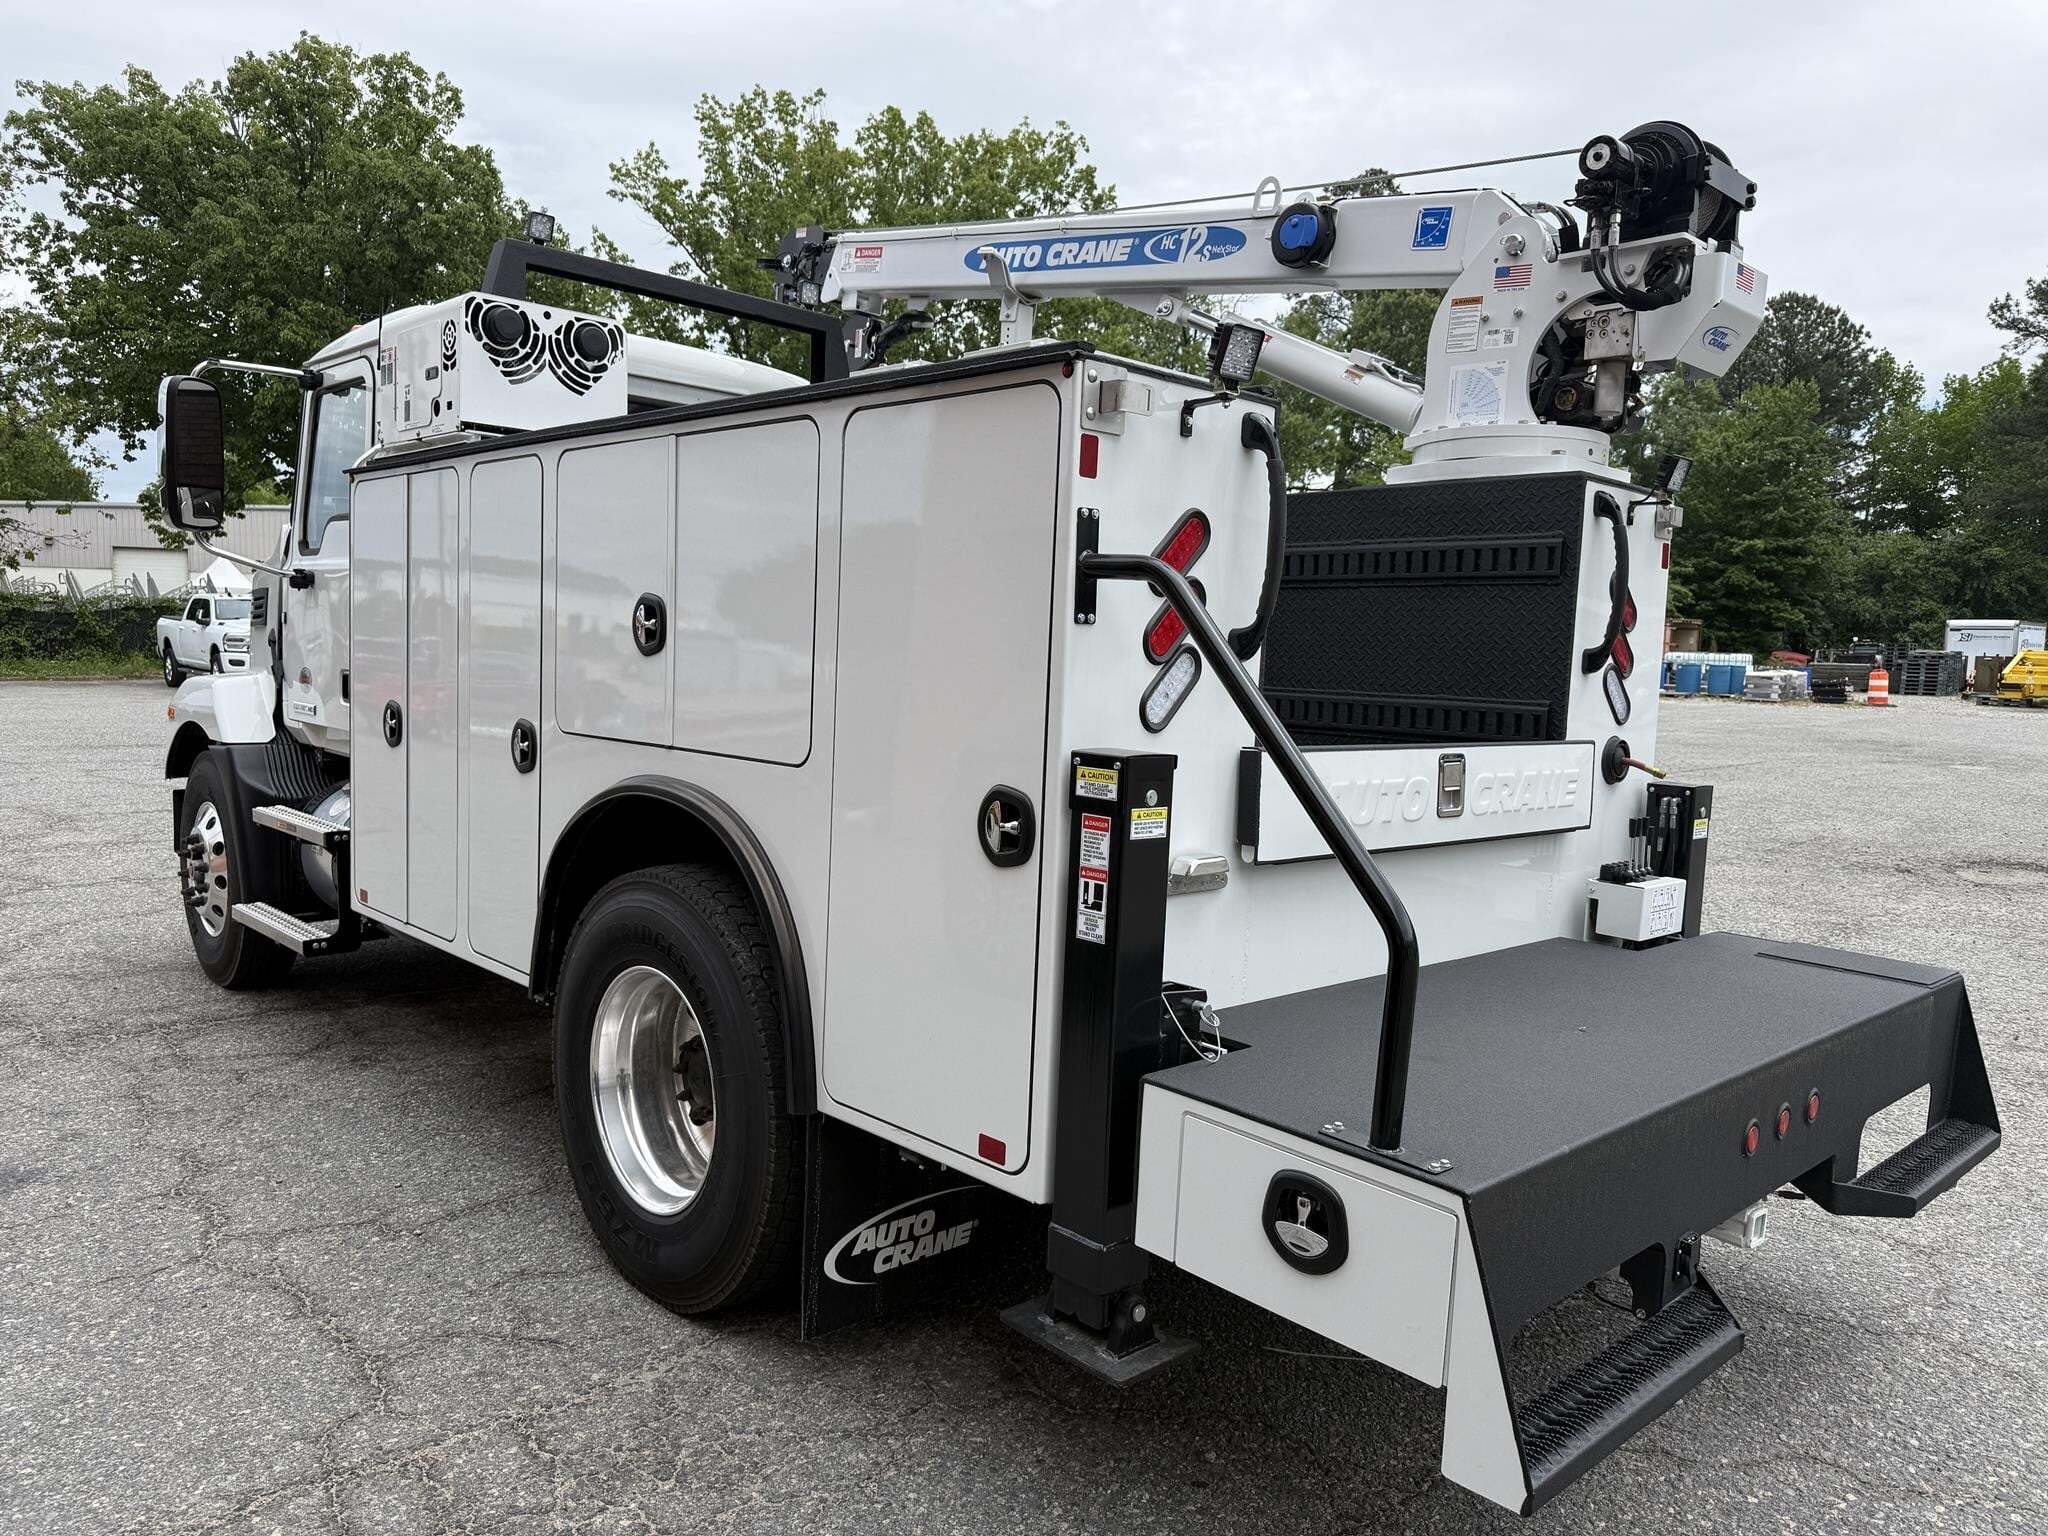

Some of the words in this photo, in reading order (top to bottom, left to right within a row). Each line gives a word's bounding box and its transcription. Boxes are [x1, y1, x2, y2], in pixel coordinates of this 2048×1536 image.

[1160, 234, 1179, 250] HC
[861, 248, 881, 256] DANGER
[1087, 771, 1114, 782] CAUTION
[1471, 768, 1580, 817] CRANE
[1089, 820, 1108, 828] DANGER
[1086, 870, 1106, 879] DANGER
[851, 1209, 936, 1257] AUTO
